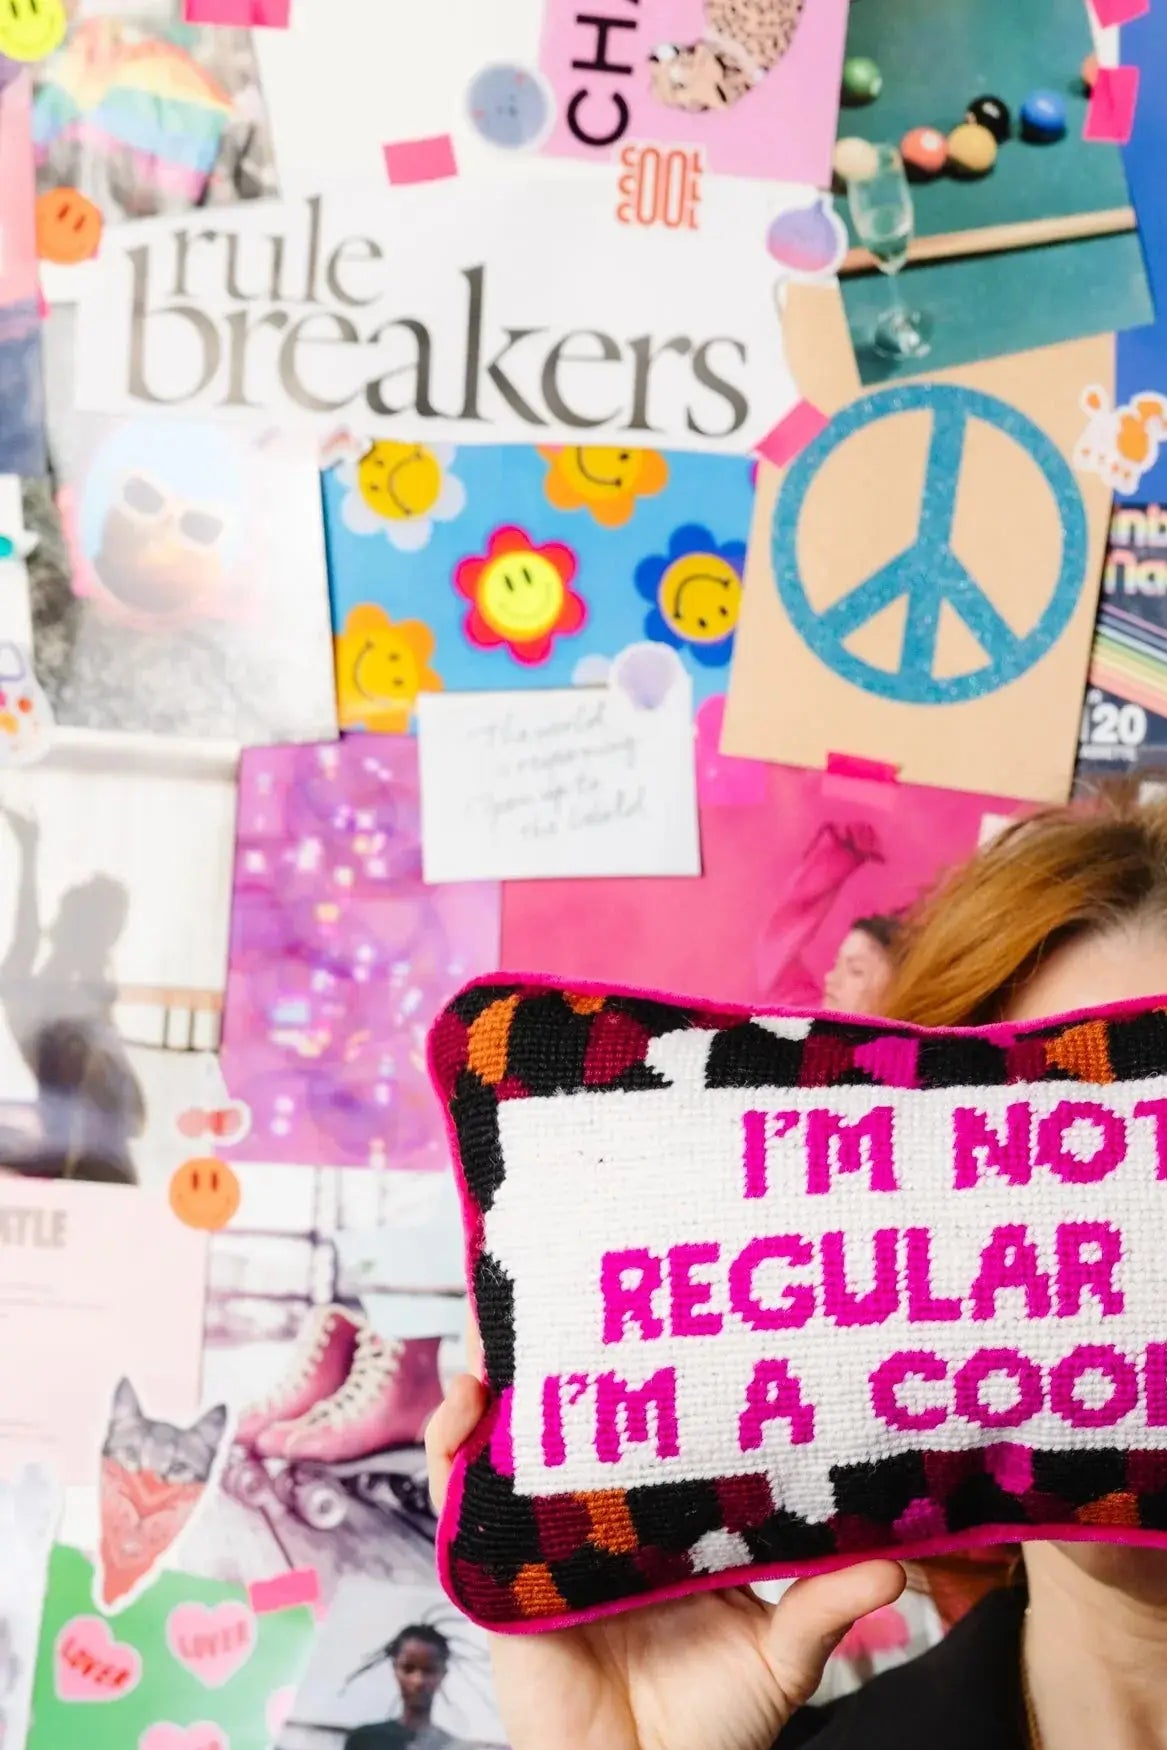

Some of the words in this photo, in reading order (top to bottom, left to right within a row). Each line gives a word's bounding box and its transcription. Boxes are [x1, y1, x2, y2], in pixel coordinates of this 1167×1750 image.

[566, 0, 638, 147] CH
[170, 193, 383, 307] rule
[125, 262, 749, 441] breakers
[742, 1105, 899, 1199] I'M
[600, 1220, 1125, 1346] REGULAR
[541, 1366, 680, 1468] I'M
[737, 1358, 815, 1452] A
[60, 1636, 131, 1688] LOVER
